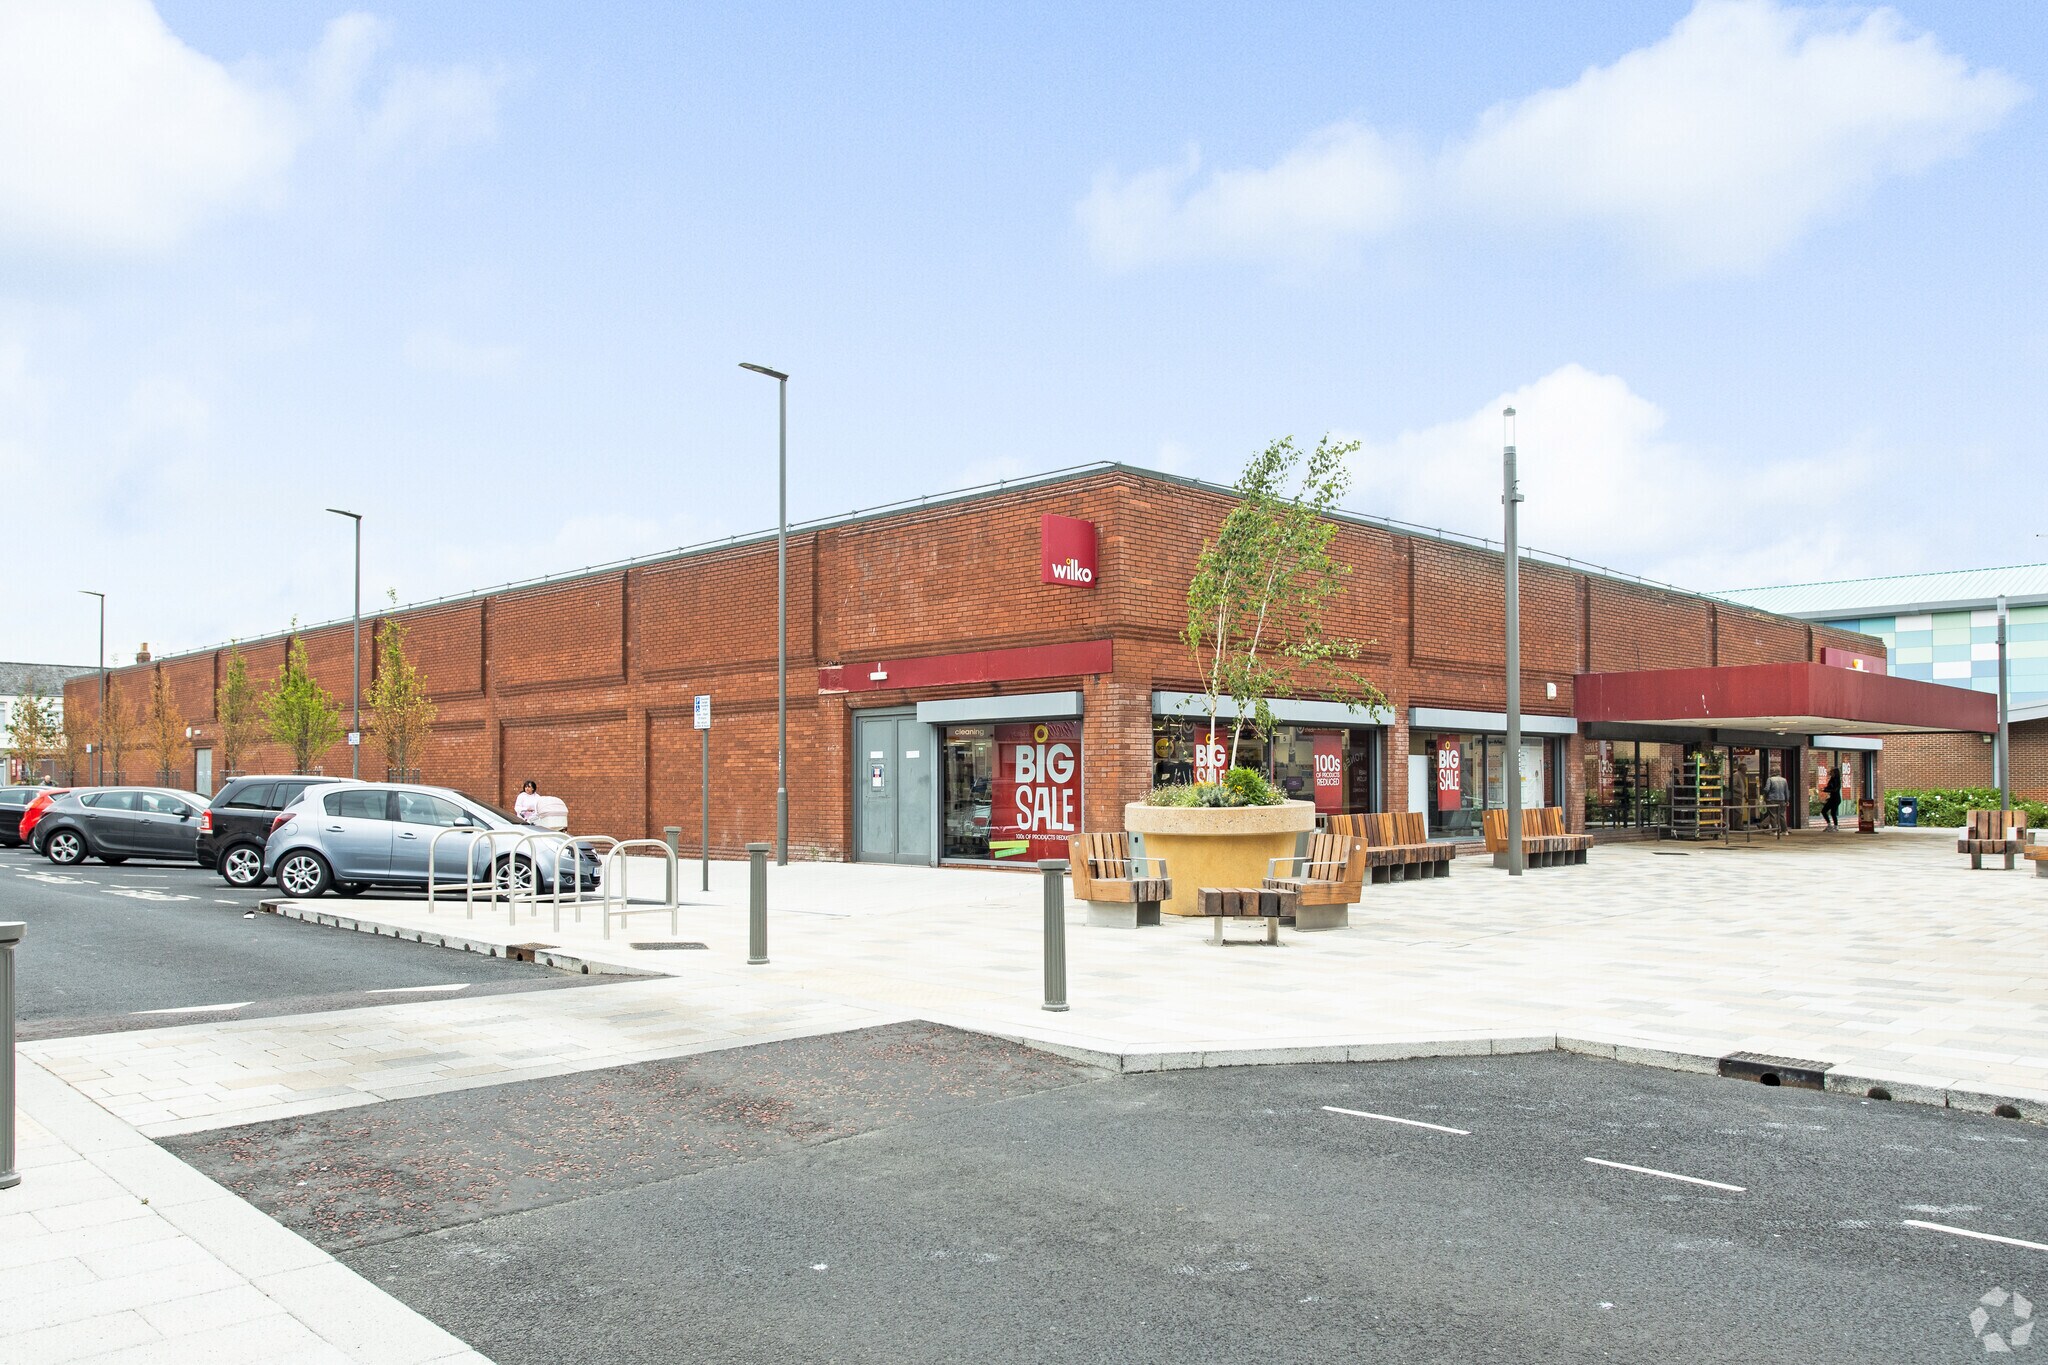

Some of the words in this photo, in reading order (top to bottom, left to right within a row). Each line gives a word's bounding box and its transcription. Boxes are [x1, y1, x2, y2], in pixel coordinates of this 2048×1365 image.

[1051, 557, 1092, 583] wilko
[954, 728, 985, 737] cleaning
[1015, 743, 1075, 784] BIG
[1195, 744, 1226, 768] BIG
[1314, 754, 1341, 772] 100s
[1438, 749, 1460, 769] BIG
[1842, 762, 1851, 775] BIG
[1316, 777, 1340, 786] REDUCED
[1439, 768, 1460, 791] SALE
[1015, 784, 1075, 832] SALE
[1031, 833, 1056, 841] PRODUCTS
